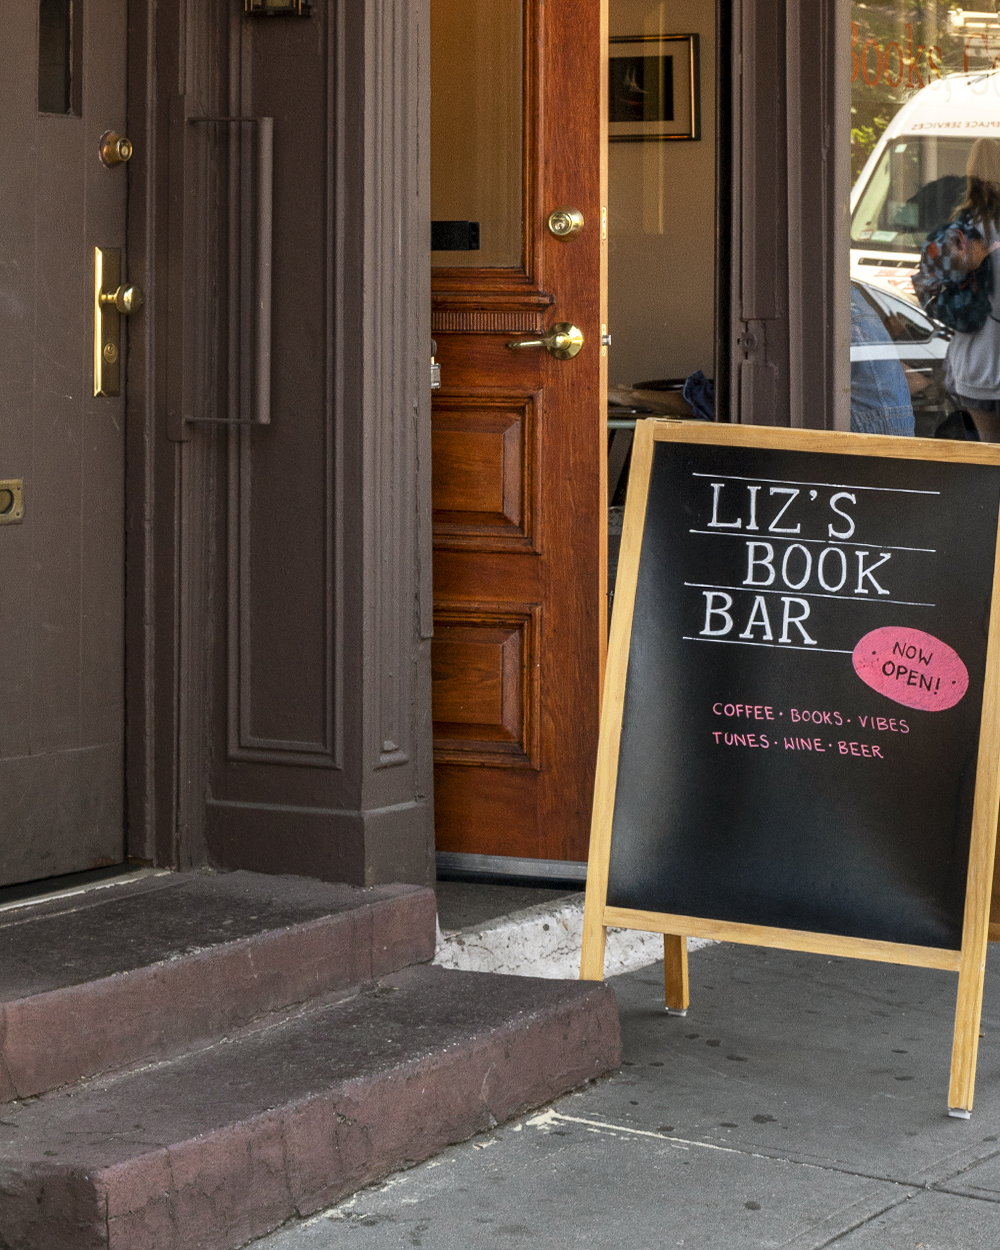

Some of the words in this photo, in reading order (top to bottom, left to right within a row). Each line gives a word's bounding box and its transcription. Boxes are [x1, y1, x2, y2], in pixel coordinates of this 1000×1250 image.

[707, 483, 857, 540] LIZ'S
[743, 541, 892, 596] BOOK
[699, 591, 818, 645] BAR
[891, 640, 934, 667] NOW
[882, 660, 942, 696] OPEN!
[712, 702, 775, 721] COFFEE
[790, 708, 844, 727] BOOKS
[858, 715, 910, 734] VIBES
[712, 731, 770, 749] TUNES
[783, 737, 826, 753] WINE
[838, 740, 884, 759] BEER
